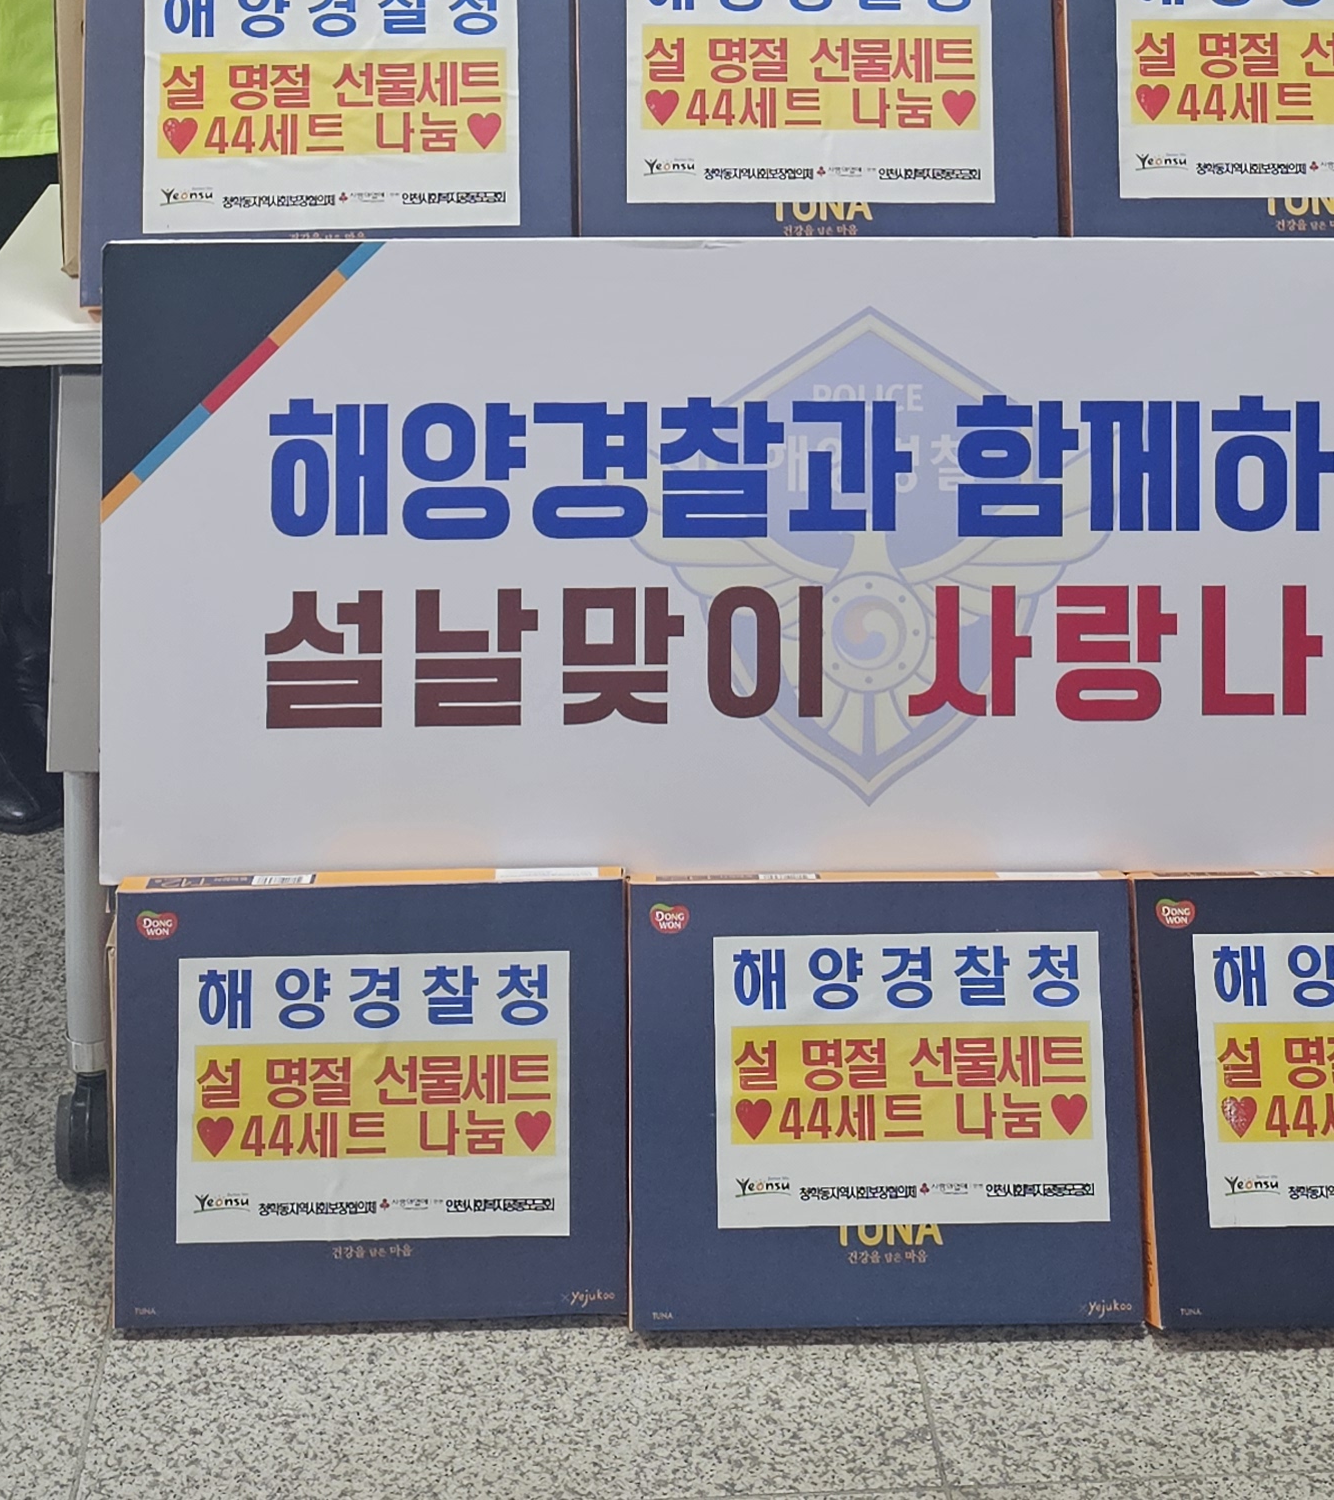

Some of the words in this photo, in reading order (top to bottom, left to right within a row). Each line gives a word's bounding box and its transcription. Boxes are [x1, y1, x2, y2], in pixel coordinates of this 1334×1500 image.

[644, 38, 685, 83] 설
[708, 37, 789, 83] 명절
[810, 37, 976, 83] 선물세트
[1134, 32, 1176, 78] 설
[1198, 32, 1279, 79] 명절
[162, 64, 205, 111] 설
[228, 63, 311, 111] 명절
[332, 60, 502, 108] 선물세트
[1176, 83, 1315, 123] 44세트
[685, 88, 822, 129] 44세트
[852, 87, 934, 129] 나눔
[204, 113, 345, 155] 44세트
[375, 112, 458, 153] 나눔
[644, 158, 695, 173] Yeonsu
[1135, 152, 1187, 167] Yeonsu
[160, 187, 214, 202] Yeonsu
[267, 396, 914, 539] 해양경찰과
[265, 584, 828, 730] 설날맞이
[142, 917, 173, 928] DONG
[655, 910, 685, 921] DONG
[658, 920, 683, 930] WON
[1161, 906, 1192, 916] DONG
[1164, 915, 1188, 926] WON
[146, 927, 170, 937] WON
[196, 1058, 242, 1110] 설
[267, 1057, 353, 1108] 명절
[373, 1054, 552, 1106] 선물세트
[734, 1039, 778, 1092] 설
[801, 1038, 888, 1092] 명절
[909, 1036, 1086, 1088] 선물세트
[1217, 1036, 1262, 1089] 설
[240, 1112, 388, 1159] 44세트
[418, 1109, 507, 1157] 나눔
[779, 1094, 925, 1142] 44세트
[955, 1093, 1043, 1140] 나눔
[194, 1192, 250, 1209] Yeonsu
[735, 1176, 791, 1193] Yeonsu
[1224, 1176, 1280, 1192] Yeonsu
